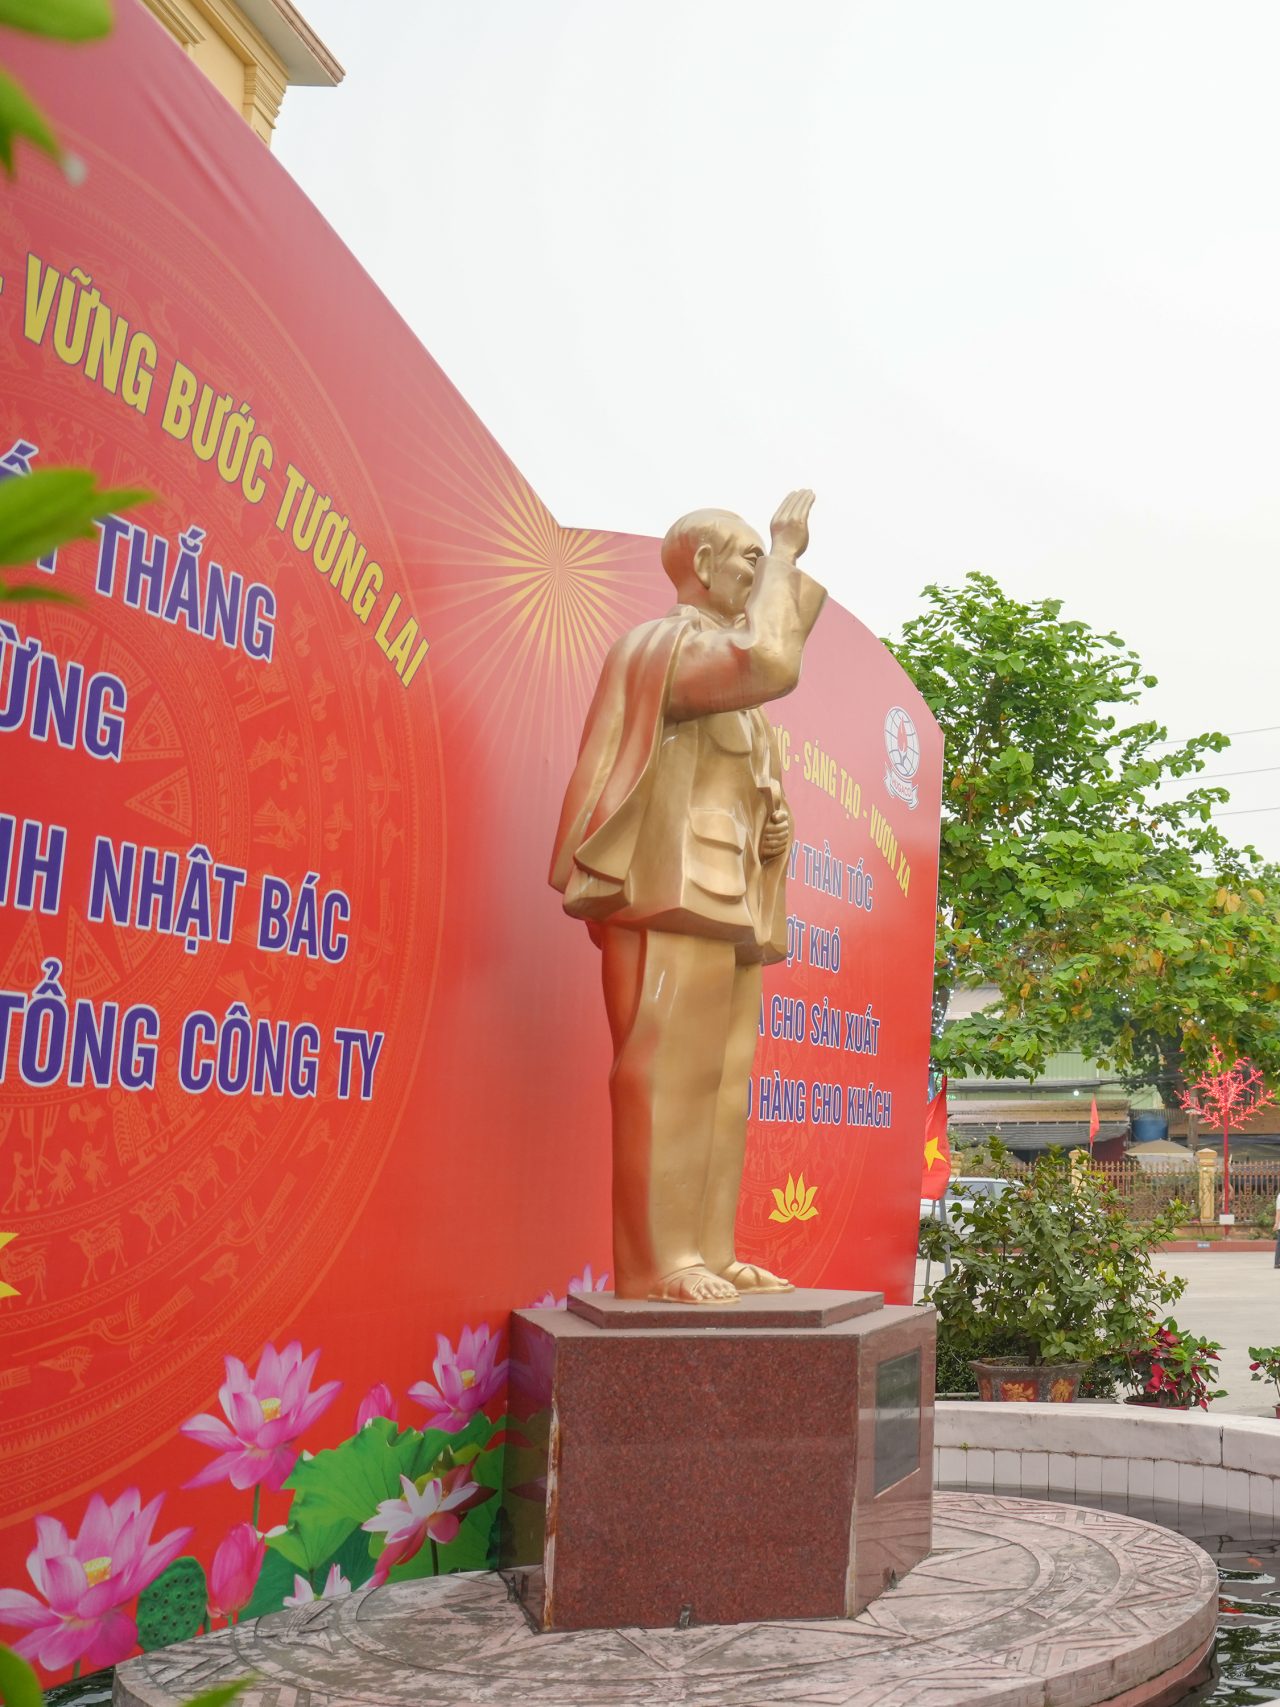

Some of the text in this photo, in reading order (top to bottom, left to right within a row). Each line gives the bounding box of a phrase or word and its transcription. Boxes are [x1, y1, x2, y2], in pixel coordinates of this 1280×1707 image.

[24, 252, 430, 689] VỮNG BƯỚC TƯƠNG LAI
[92, 513, 277, 664] THẮNG
[803, 739, 837, 798] SÁNG
[840, 768, 861, 819] TẠO
[870, 803, 898, 871] VƯƠN
[896, 850, 911, 898] XA
[87, 835, 247, 955] NHẬT
[257, 871, 352, 963] BÁC
[803, 839, 843, 899] THẦN
[846, 857, 873, 912] TỐC
[809, 925, 840, 973] KHÓ
[178, 1002, 320, 1099] CÔNG
[334, 1028, 384, 1101] TY
[770, 994, 806, 1043] CHO
[810, 996, 841, 1049] SẢN
[844, 1004, 880, 1056] XUẤT
[759, 1070, 806, 1123] HÀNG
[811, 1082, 842, 1126] CHO
[846, 1082, 892, 1129] KHÁCH
